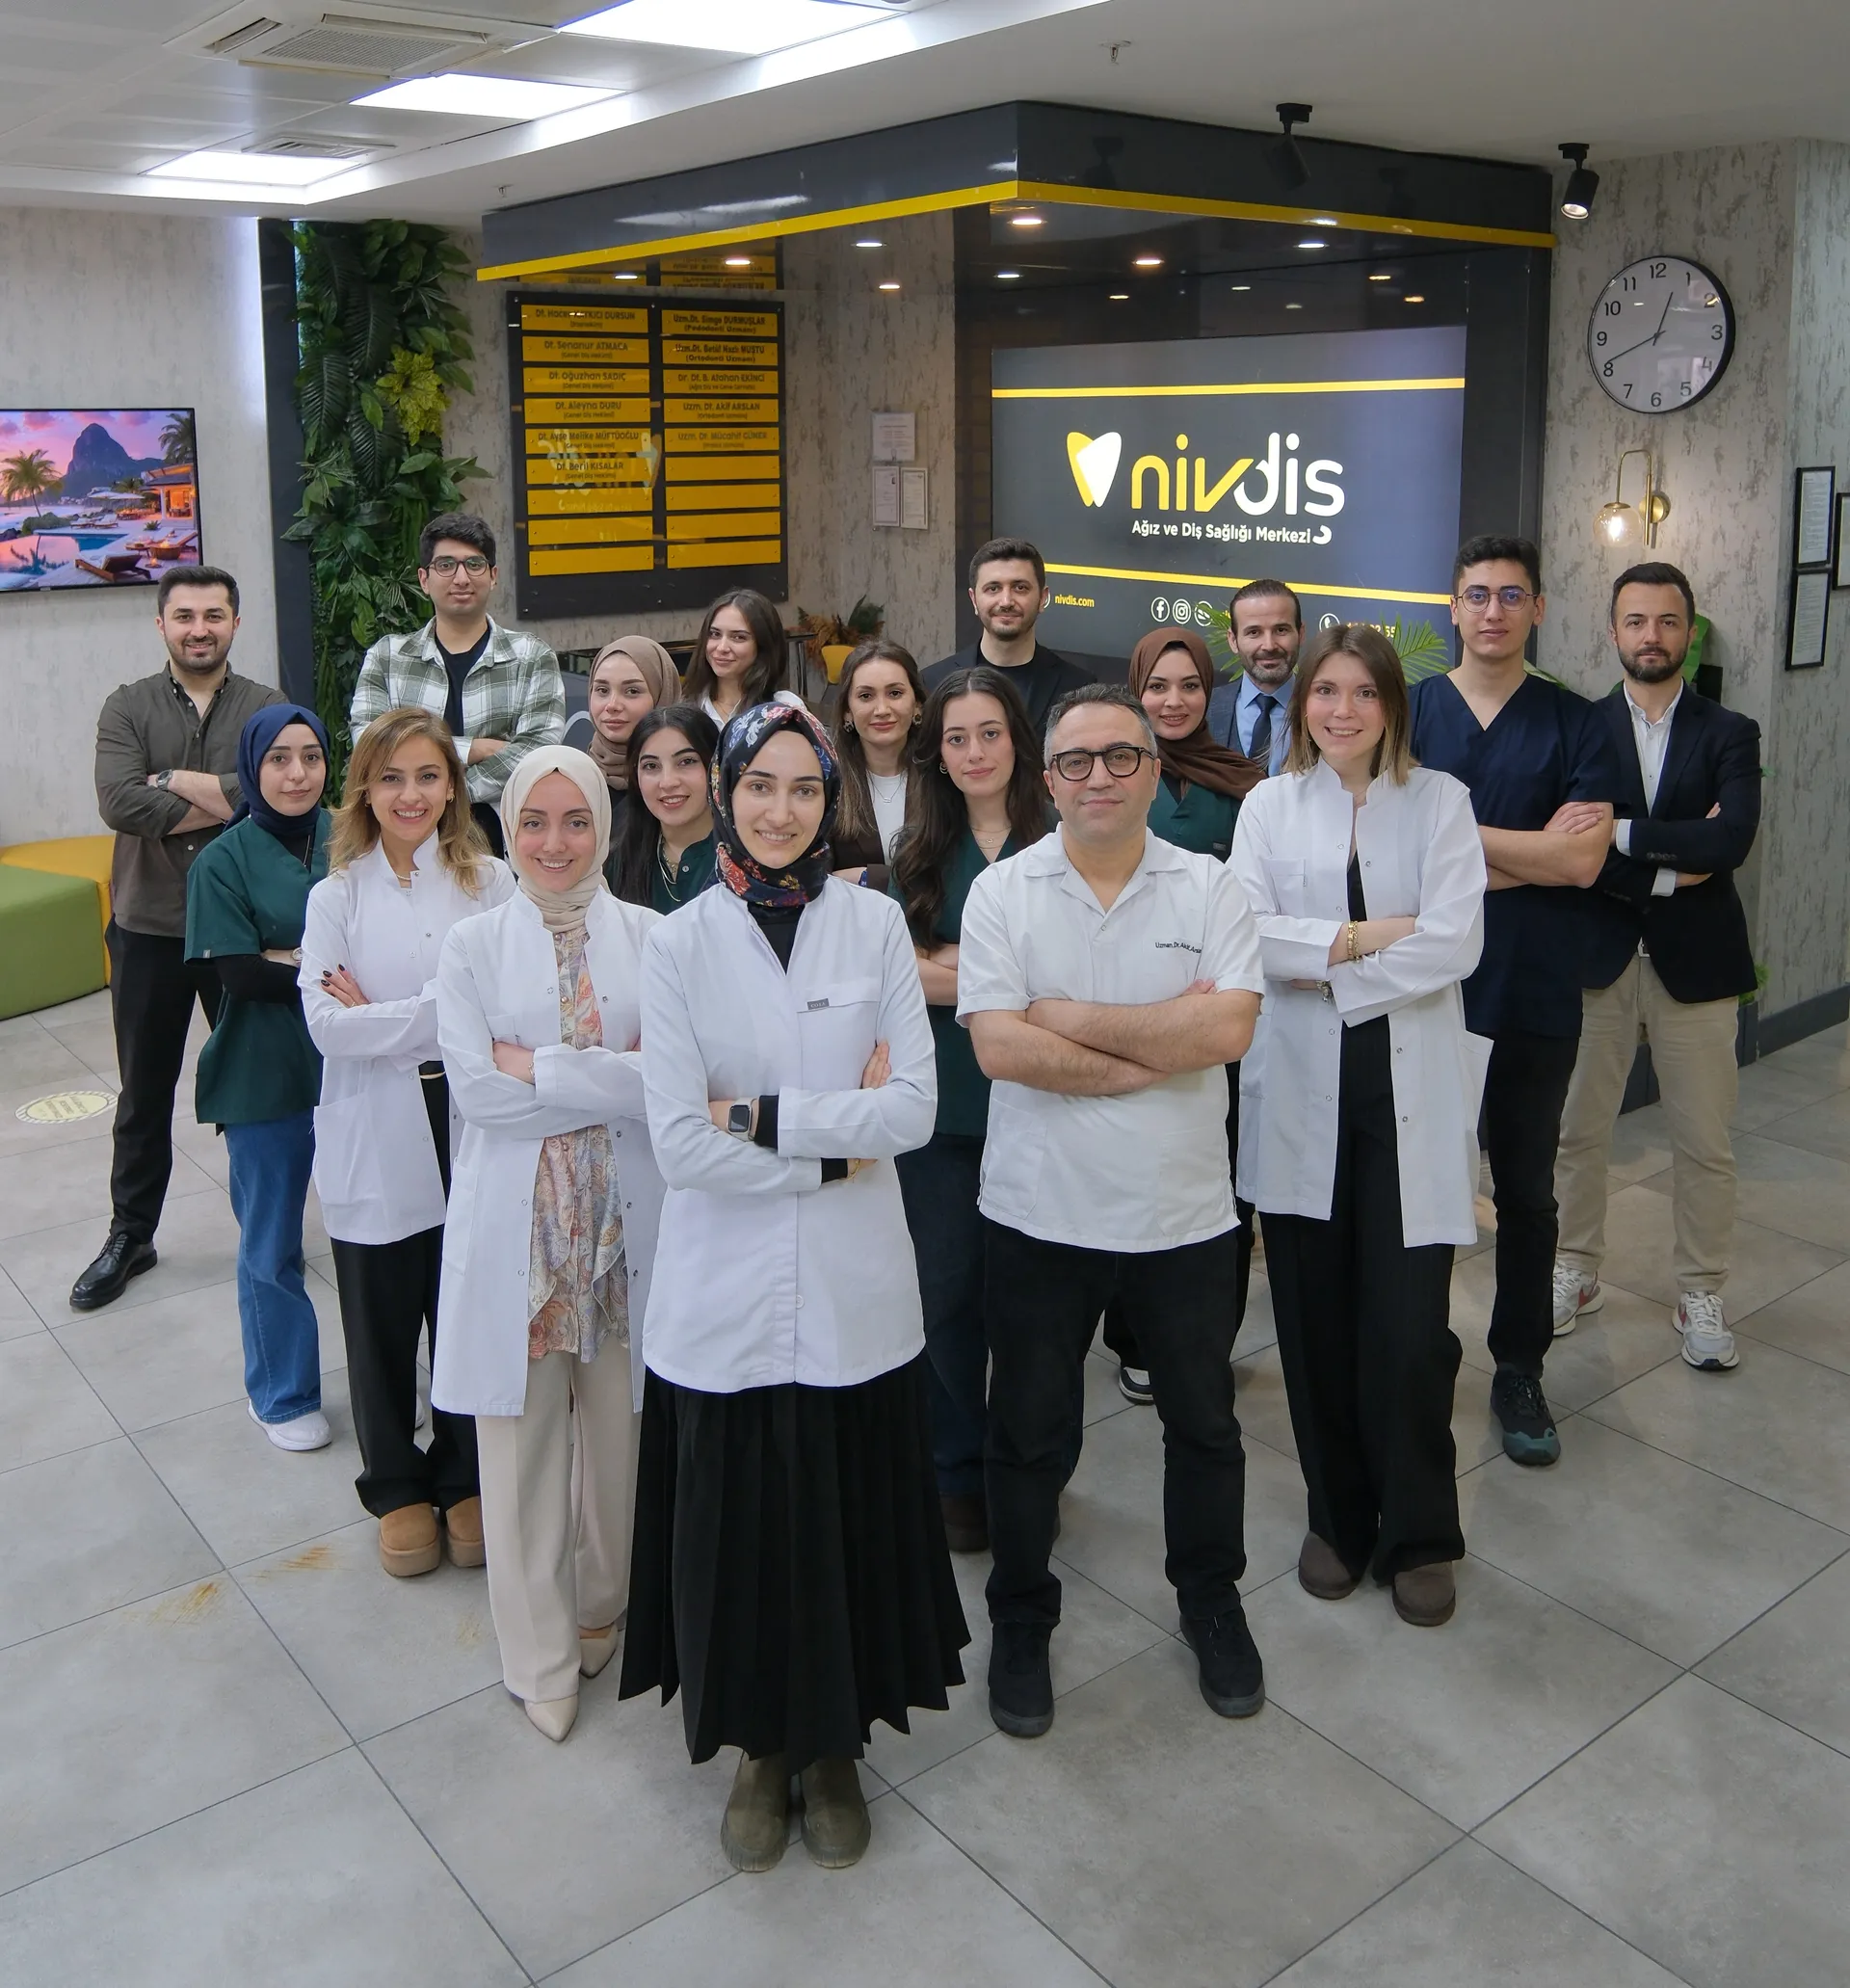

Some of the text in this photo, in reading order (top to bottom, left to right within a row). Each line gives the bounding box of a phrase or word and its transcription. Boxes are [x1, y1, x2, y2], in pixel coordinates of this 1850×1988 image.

[1650, 262, 1667, 279] 12
[1623, 277, 1636, 291] 11
[1686, 272, 1691, 286] 1
[604, 311, 635, 320] DURSUN
[1604, 301, 1621, 316] 10
[1597, 331, 1607, 346] 9
[1711, 325, 1723, 340] 3
[543, 340, 556, 349] Dt.
[595, 342, 628, 351] ATMACA
[1603, 361, 1614, 377] 8
[1702, 357, 1712, 372] 4
[548, 371, 560, 380] Dt.
[561, 371, 601, 382] Oğuzhan
[1624, 384, 1633, 399] 7
[1679, 381, 1692, 397] 5
[555, 401, 622, 411] Dt. Aleyna DURU
[1651, 392, 1662, 408] 6
[550, 433, 568, 442] Ayşe
[568, 462, 589, 470] Beril
[590, 462, 624, 470] KISALAR
[1130, 432, 1345, 517] nivdis
[1131, 519, 1311, 543] Ağız ve Diş Sağlığı Merkezi
[1054, 594, 1095, 608] nivdis.com
